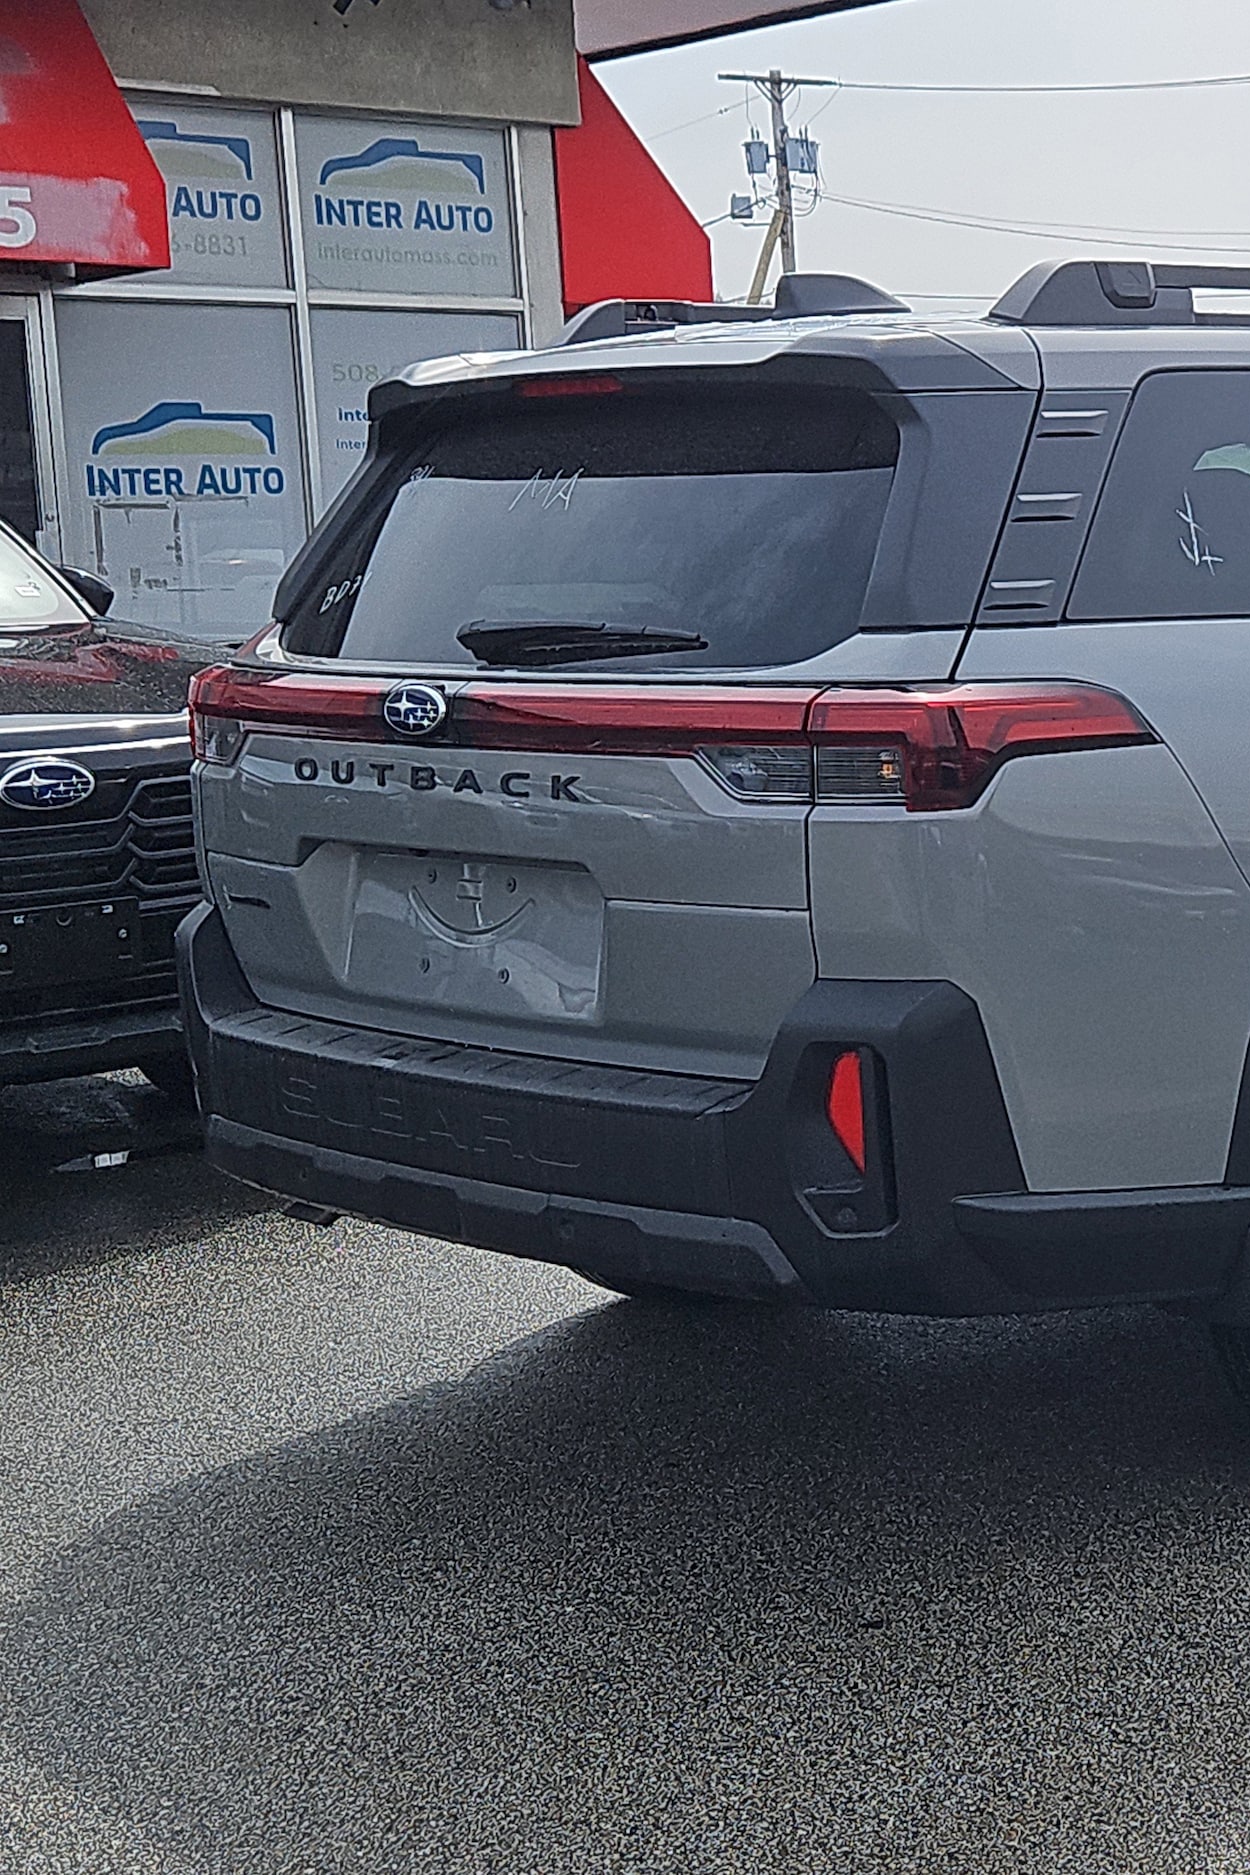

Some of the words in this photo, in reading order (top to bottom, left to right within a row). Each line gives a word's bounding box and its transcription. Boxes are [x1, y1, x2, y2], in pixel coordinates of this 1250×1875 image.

[172, 186, 262, 222] AUTO
[314, 194, 404, 230] INTER
[414, 199, 494, 233] AUTO
[86, 464, 185, 497] INTER
[197, 464, 285, 495] AUTO
[294, 757, 582, 802] OUTBACK
